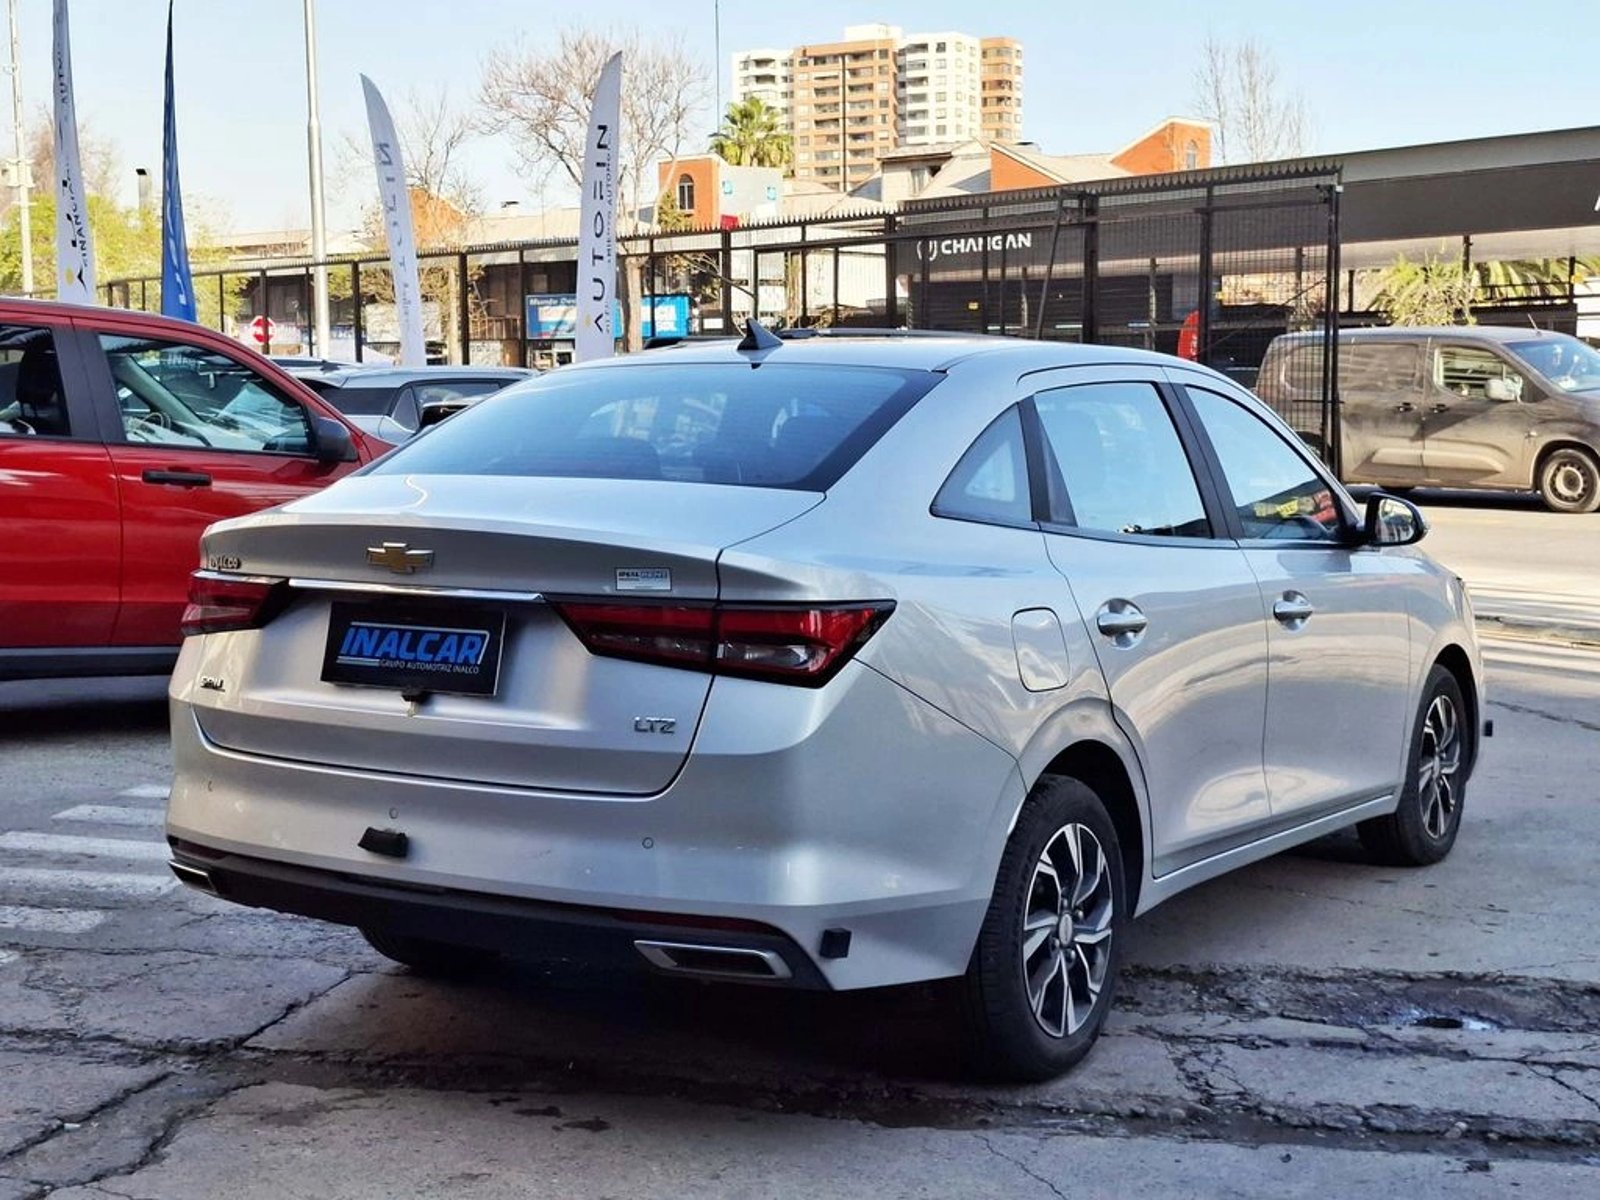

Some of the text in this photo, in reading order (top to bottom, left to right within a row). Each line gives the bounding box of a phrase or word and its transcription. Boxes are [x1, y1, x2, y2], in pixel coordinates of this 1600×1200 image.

[941, 232, 1032, 254] CHANGAN
[340, 626, 483, 665] INALCAR
[380, 658, 479, 675] GRUPO AUTOMOTRIZ INALCO
[633, 716, 676, 735] LTZ
